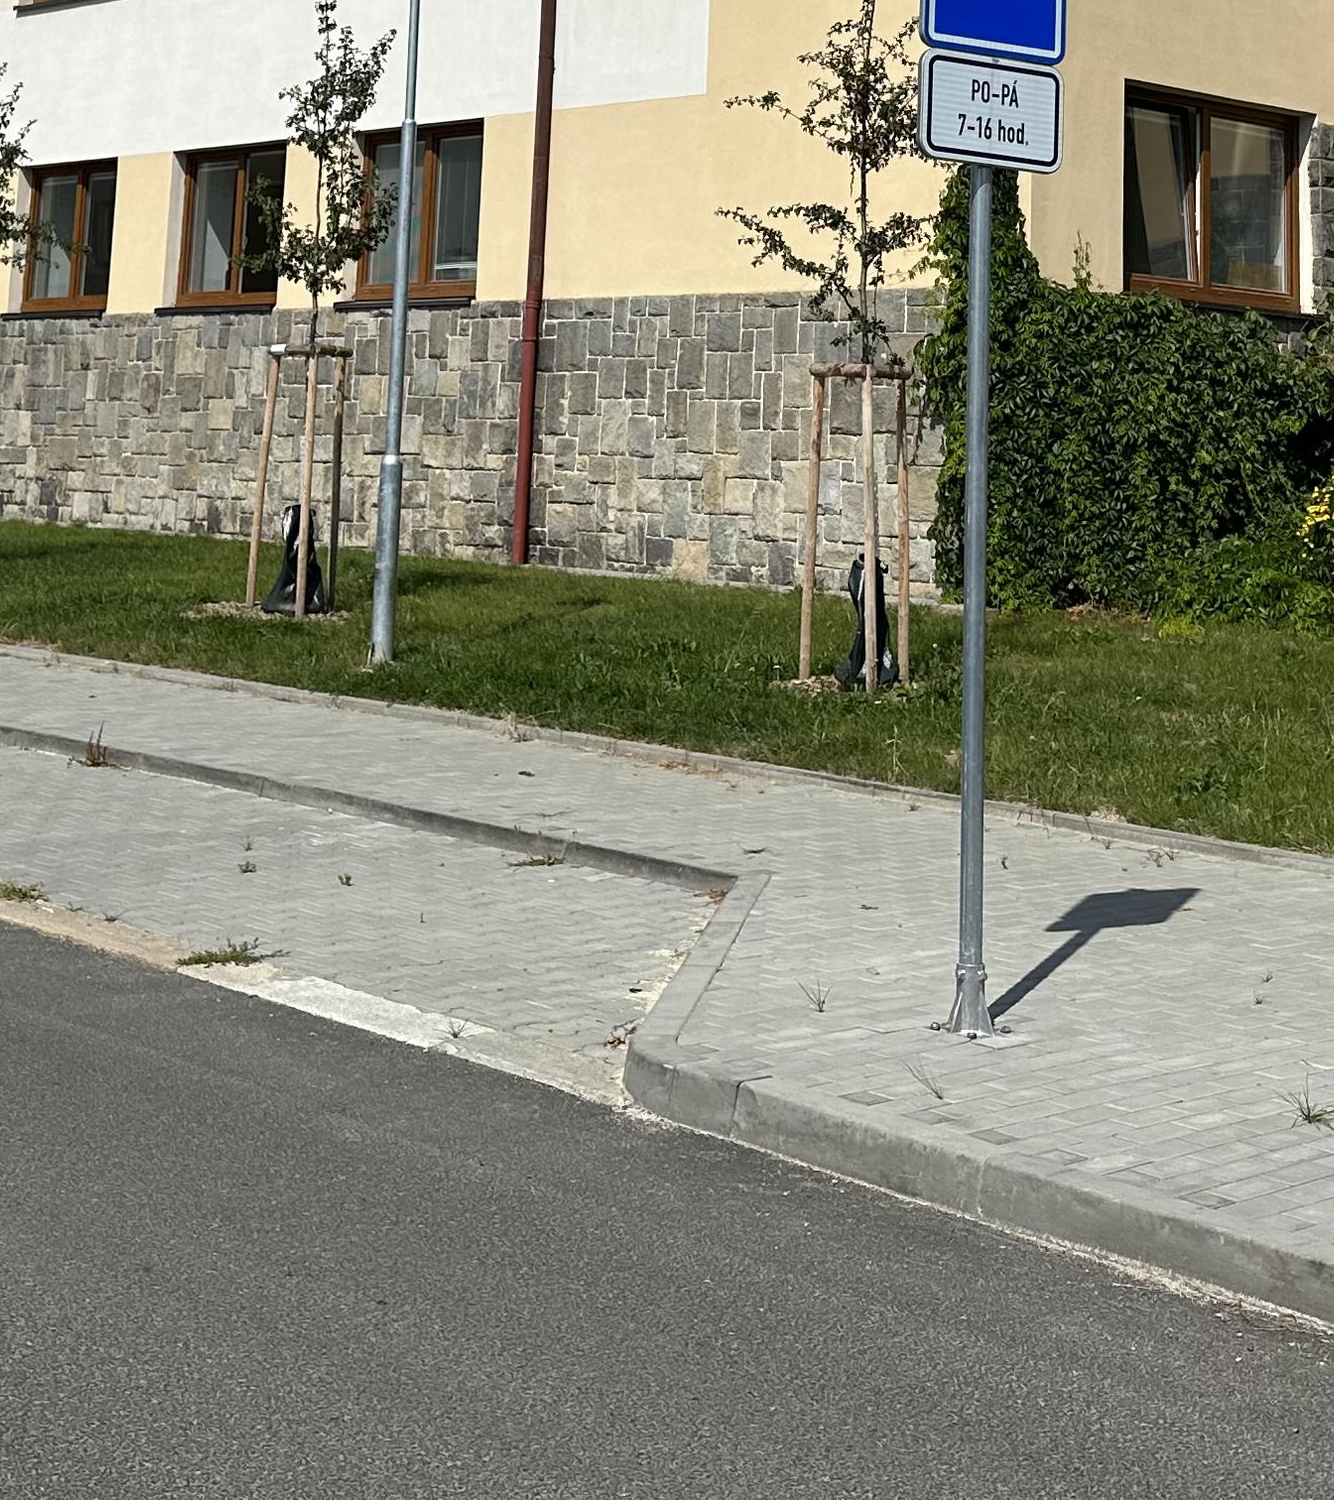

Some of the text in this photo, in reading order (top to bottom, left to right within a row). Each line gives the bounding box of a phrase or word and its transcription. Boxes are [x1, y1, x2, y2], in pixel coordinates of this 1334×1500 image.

[971, 78, 1019, 108] PO-PÁ
[958, 113, 1029, 147] 7-16 hod.
